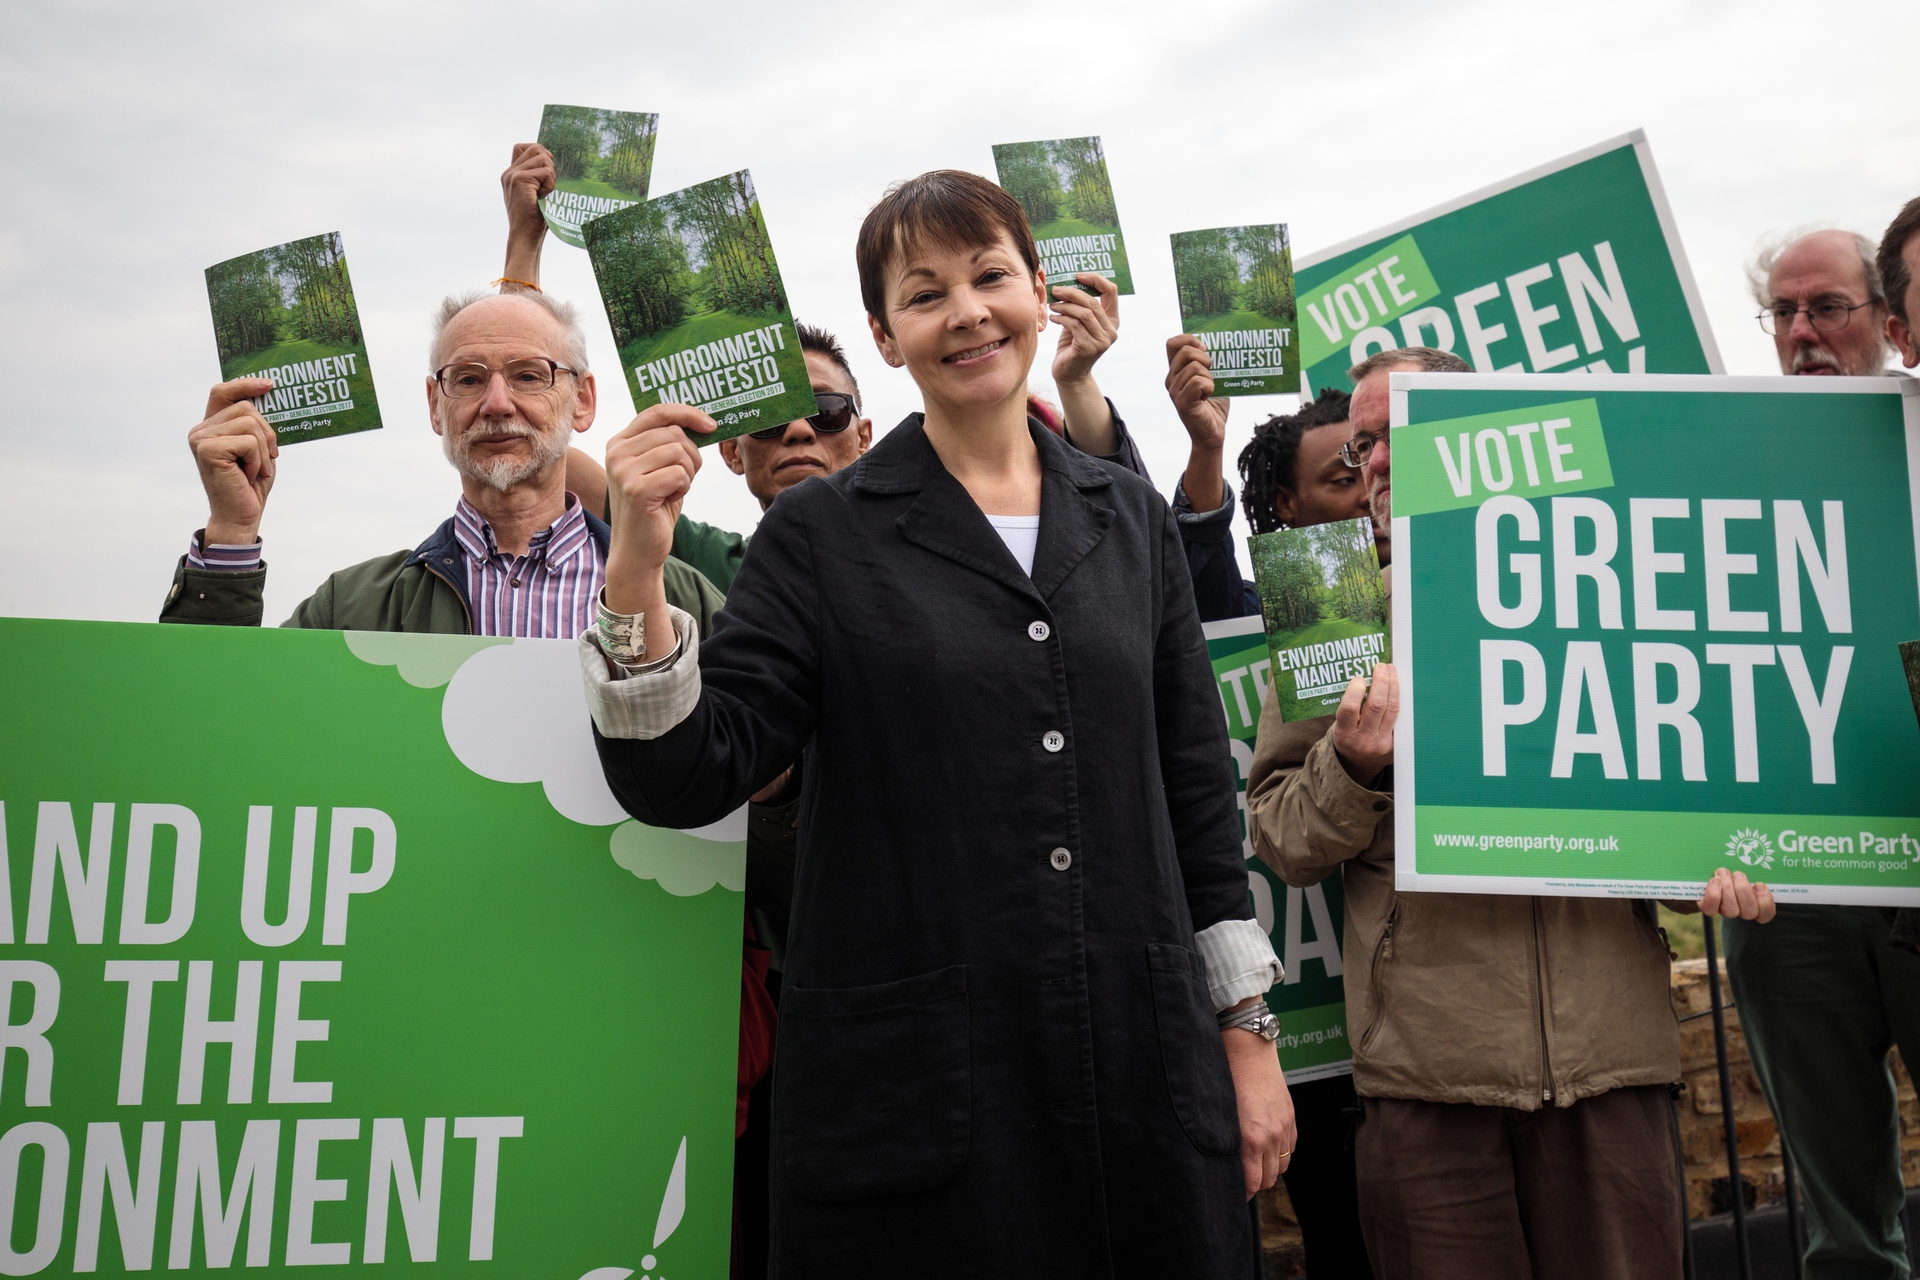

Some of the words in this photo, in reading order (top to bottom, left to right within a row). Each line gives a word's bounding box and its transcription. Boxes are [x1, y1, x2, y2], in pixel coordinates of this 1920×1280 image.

[545, 190, 639, 214] NVIRONMEN
[545, 200, 606, 225] MANIFE
[1036, 234, 1117, 258] NVIRONMENT
[1306, 255, 1418, 345] VOTE
[1192, 328, 1291, 350] NVIRONMENT
[635, 323, 785, 392] ENVIRONMENT
[231, 353, 357, 389] RONMENT
[657, 356, 780, 405] MANIFESTO
[1250, 379, 1265, 387] Party
[711, 399, 738, 411] GENERAL
[738, 391, 766, 403] ELECTION
[766, 384, 782, 397] 2017
[269, 413, 285, 423] PARTY
[289, 408, 313, 419] GENERAL
[313, 403, 338, 415] ELECTION
[338, 402, 351, 410] 2017
[277, 424, 300, 433] Green
[312, 418, 332, 427] Party
[738, 408, 760, 420] Party
[1434, 418, 1583, 498] VOTE
[1475, 495, 1853, 634] GREEN
[1278, 633, 1385, 671] ENVIRONMENT
[1299, 689, 1314, 698] GREEN
[1314, 687, 1328, 696] PARTY
[1321, 697, 1340, 706] Green
[1479, 639, 1855, 785] PARTY
[1433, 834, 1620, 854] www.greenparty.org.uk
[1778, 829, 1853, 853] Green
[1859, 832, 1920, 863] Party
[0, 801, 202, 945] ND
[240, 805, 397, 947] UP
[1782, 855, 1799, 867] for
[1802, 857, 1822, 868] the
[1824, 859, 1876, 869] common
[1878, 859, 1908, 872] good
[104, 960, 343, 1106] THE
[1276, 1024, 1343, 1048] arty.org.uk
[0, 1116, 525, 1276] ONMENT
